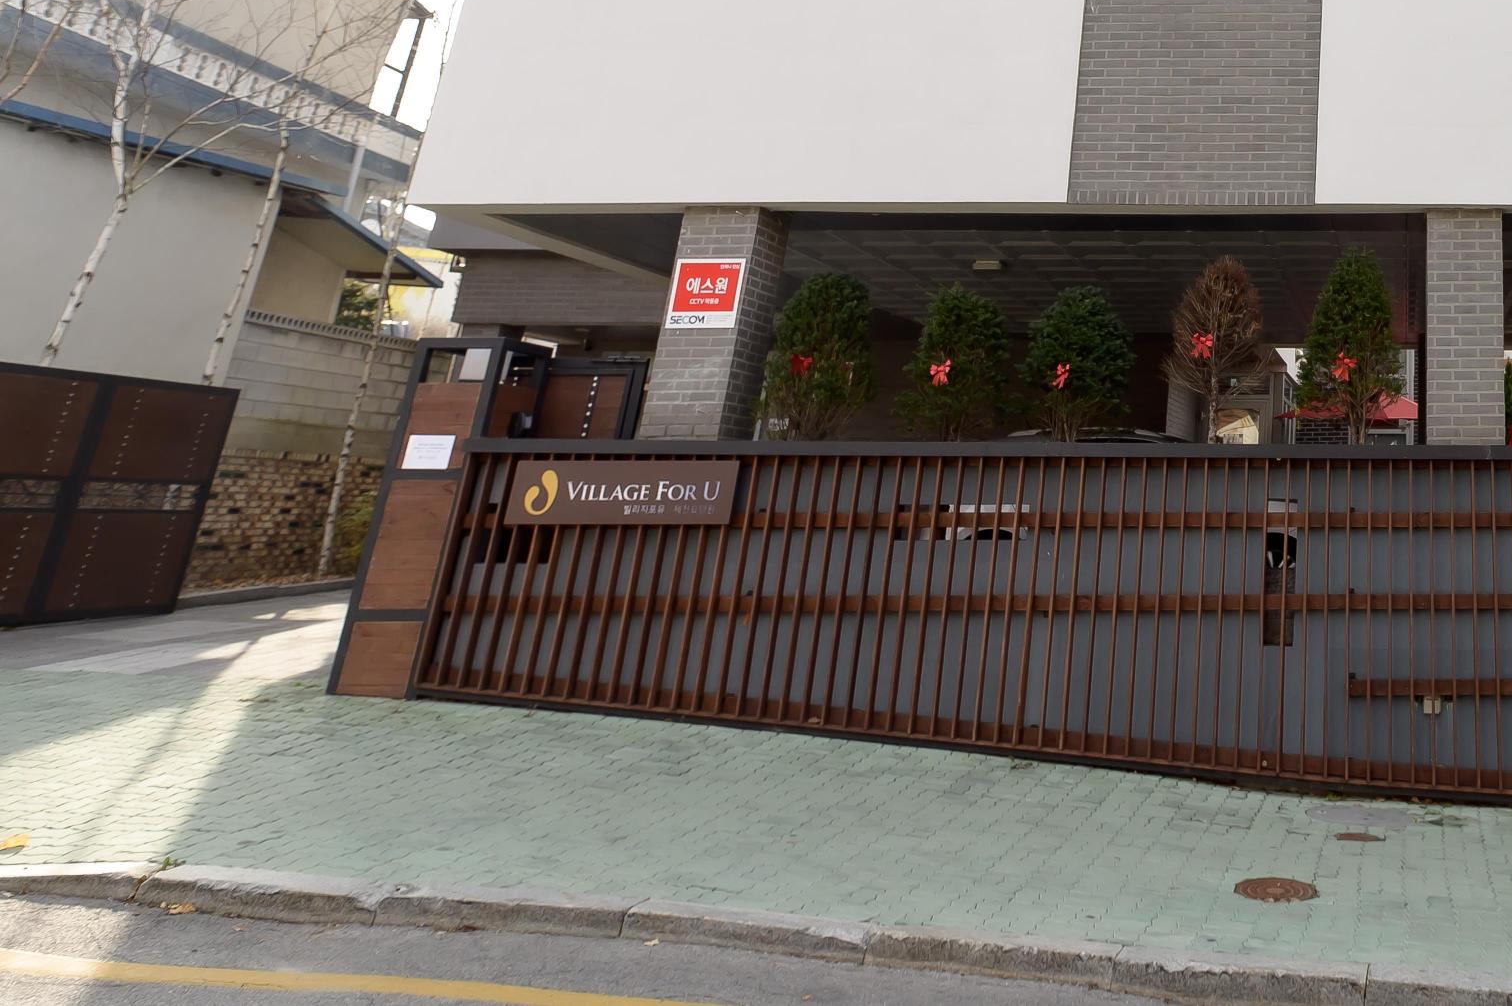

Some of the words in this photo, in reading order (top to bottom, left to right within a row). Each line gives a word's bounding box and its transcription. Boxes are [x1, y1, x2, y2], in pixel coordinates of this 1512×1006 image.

[686, 277, 729, 294] 에스원
[670, 315, 705, 325] SECOM
[703, 481, 721, 501] U
[623, 504, 666, 515] 빌리지포유
